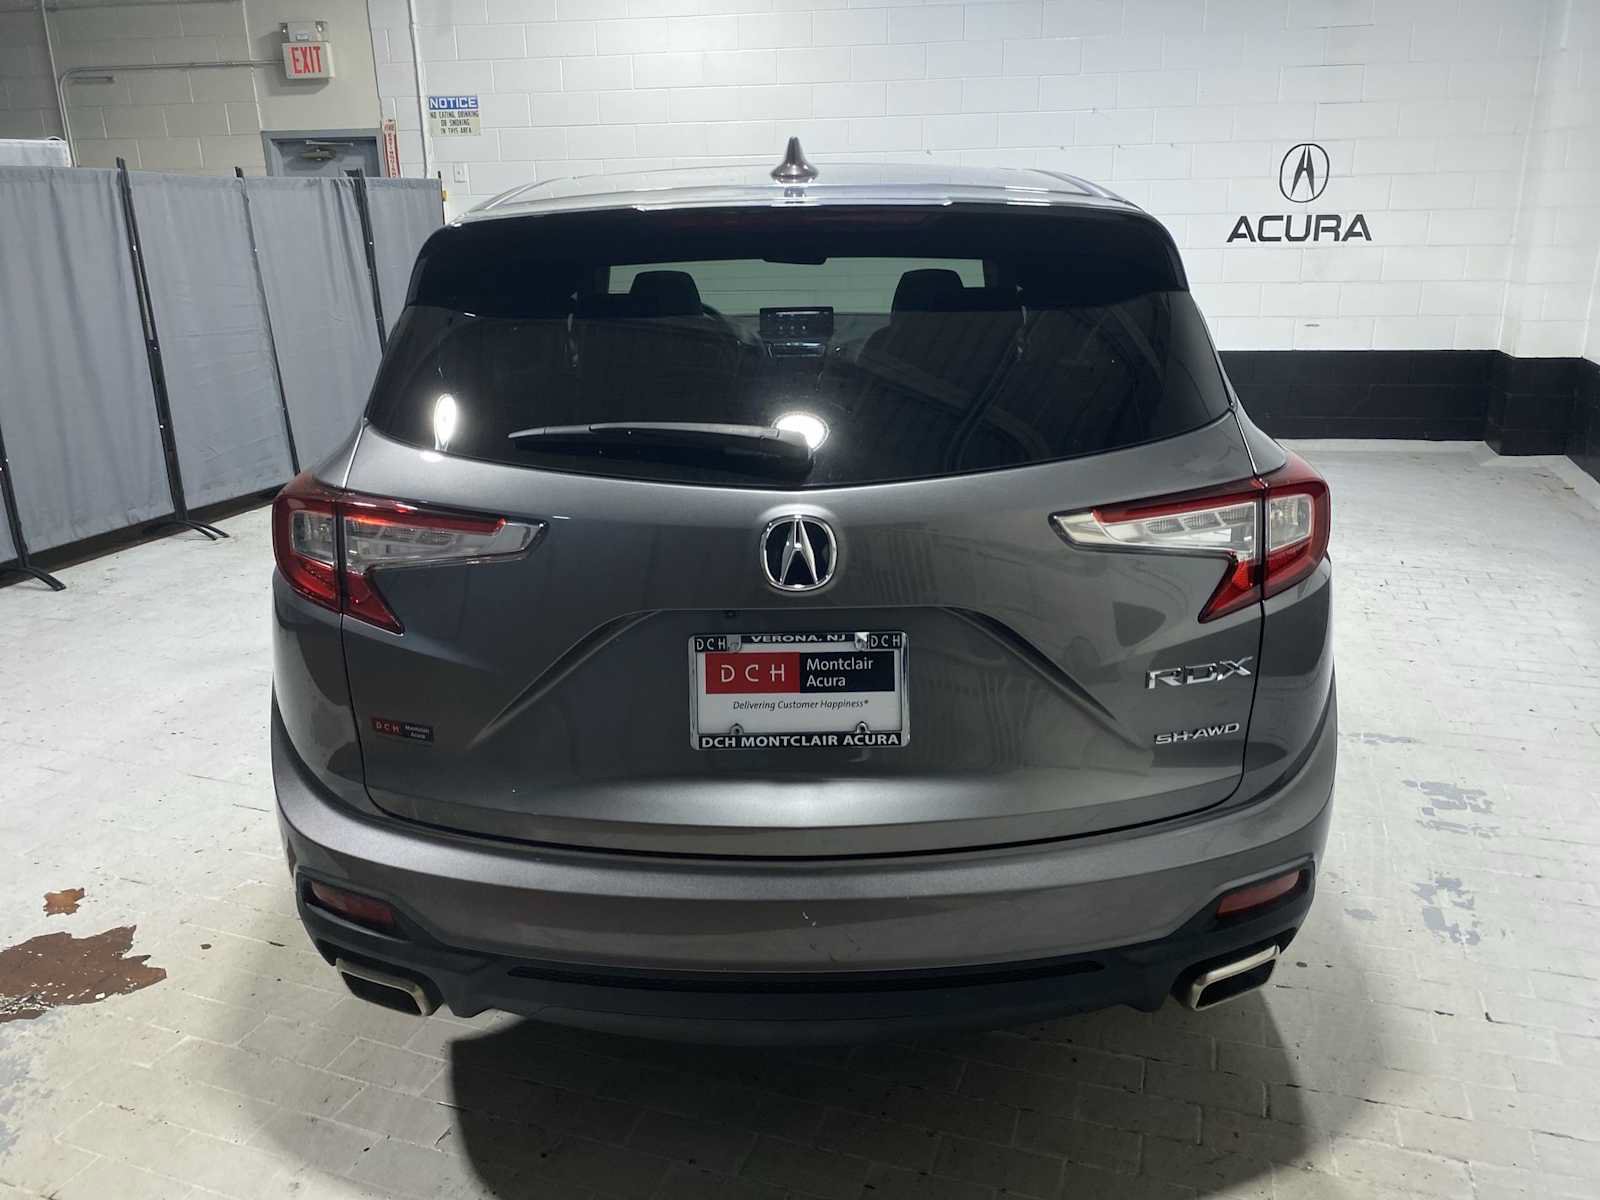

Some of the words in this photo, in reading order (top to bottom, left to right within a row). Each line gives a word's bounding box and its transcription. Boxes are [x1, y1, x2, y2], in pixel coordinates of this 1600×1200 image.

[291, 46, 322, 74] EXIT
[430, 97, 478, 109] NOTICE
[1226, 213, 1373, 243] ACURA
[827, 634, 846, 642] NJ
[806, 656, 874, 671] Montclair
[1145, 656, 1254, 689] RDX
[806, 674, 847, 688] Acura
[732, 700, 776, 712] Delivering
[777, 699, 819, 710] Customer
[702, 736, 737, 748] DCH
[740, 735, 839, 747] MONTCLAIR
[842, 733, 900, 746] ACURA
[1154, 722, 1241, 745] SH-AWD
